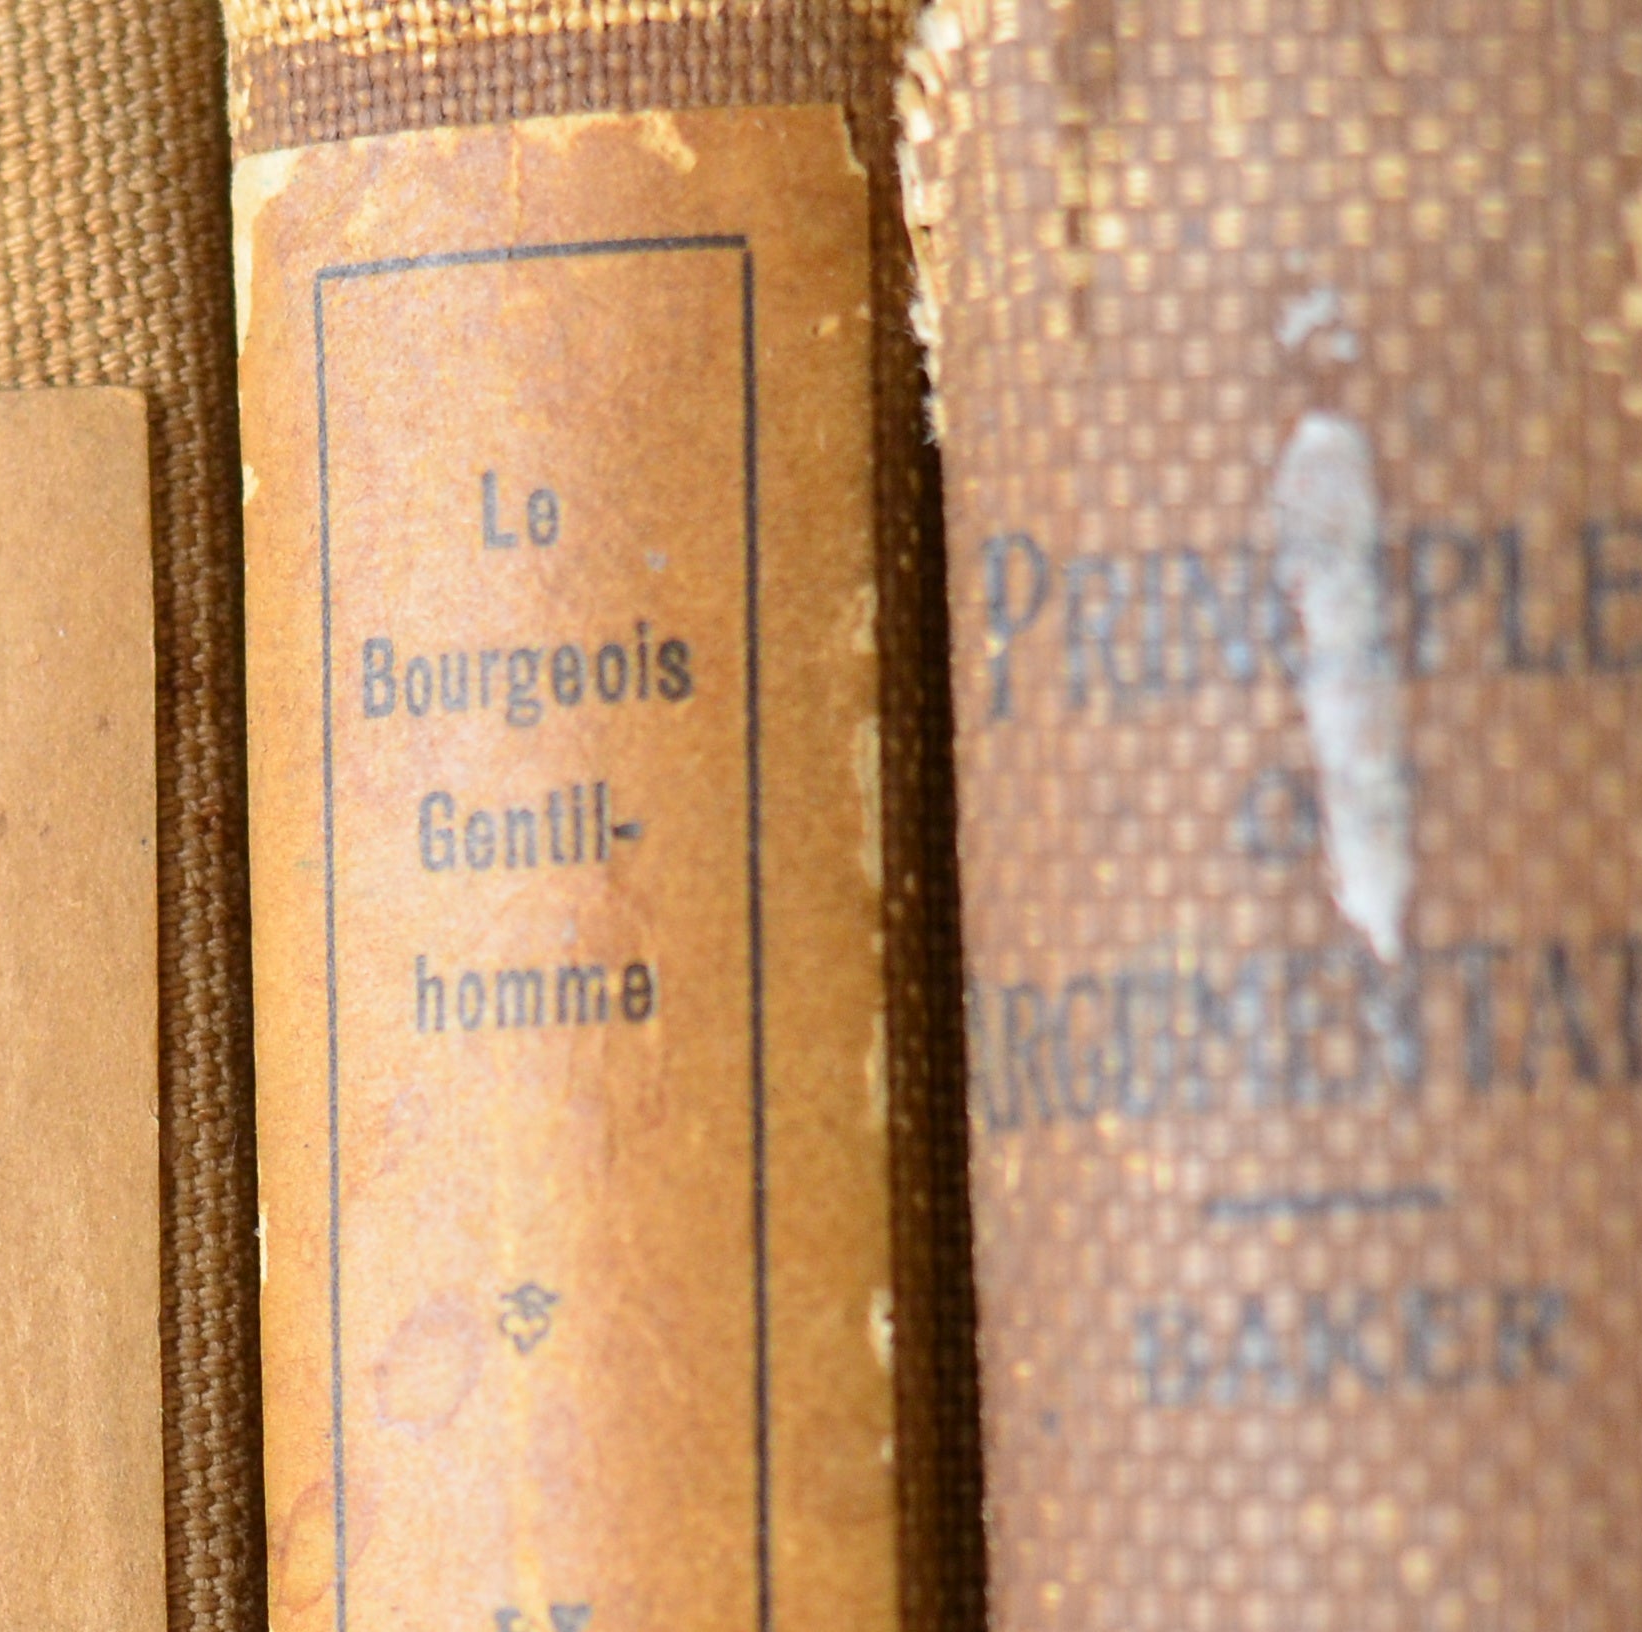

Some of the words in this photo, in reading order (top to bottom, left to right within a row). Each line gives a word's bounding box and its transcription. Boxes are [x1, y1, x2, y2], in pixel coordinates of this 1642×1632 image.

[480, 468, 560, 550] Le
[361, 619, 695, 728] Bourgeois
[417, 780, 645, 871] Gentil-
[414, 955, 657, 1034] homme
[1133, 1284, 1572, 1402] BAKER
